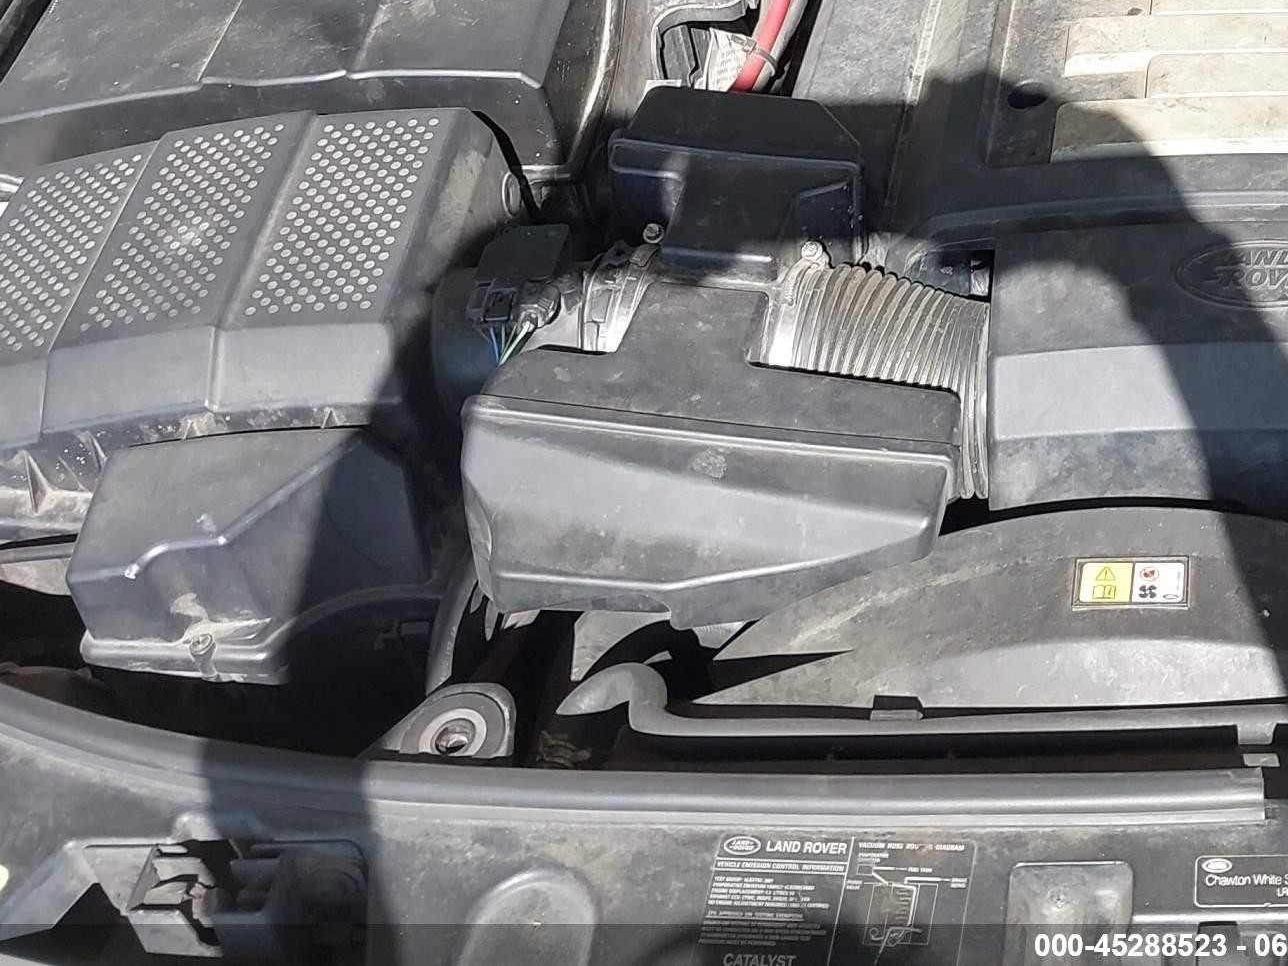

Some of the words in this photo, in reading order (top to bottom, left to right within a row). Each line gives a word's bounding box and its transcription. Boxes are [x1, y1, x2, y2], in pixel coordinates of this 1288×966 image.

[765, 840, 801, 853] LAND
[803, 841, 848, 854] ROVER
[1205, 873, 1251, 886] Chawton
[1253, 873, 1282, 885] White
[723, 952, 798, 966] CATALYST
